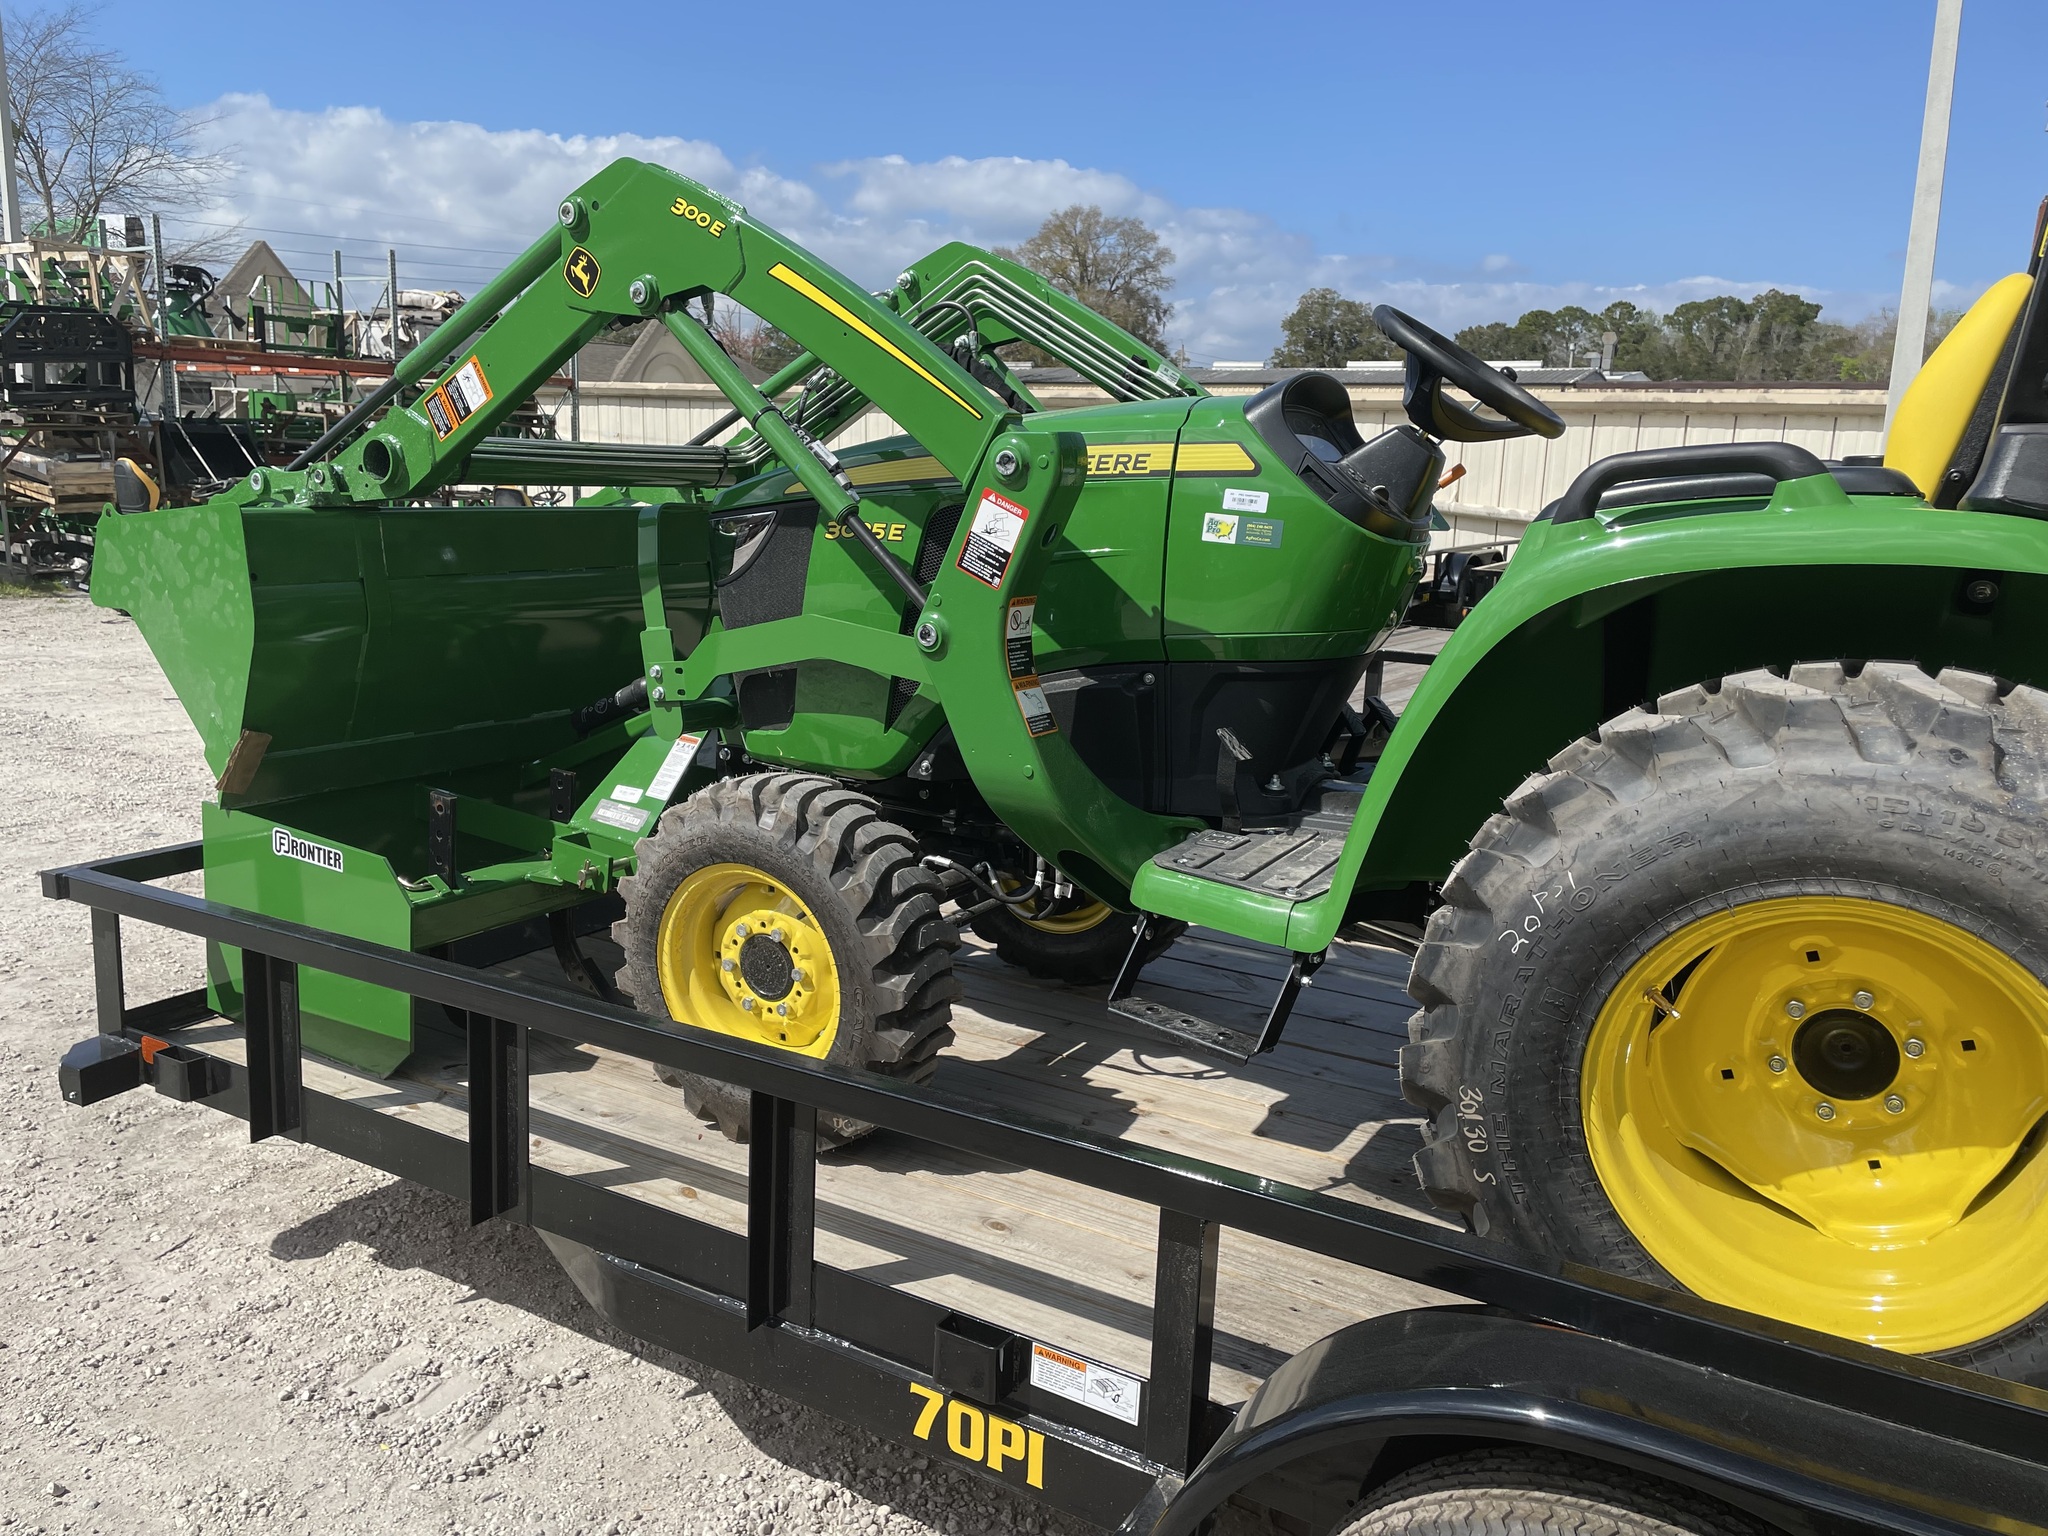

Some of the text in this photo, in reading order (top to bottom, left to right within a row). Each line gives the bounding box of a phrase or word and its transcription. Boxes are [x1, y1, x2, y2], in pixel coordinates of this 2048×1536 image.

[670, 197, 727, 239] 300E
[996, 497, 1023, 516] DANGER
[824, 520, 906, 541] 305E
[274, 829, 342, 870] FRONTIER
[1489, 831, 1696, 1096] MARATHONER
[1491, 1113, 1526, 1205] THE
[1044, 1350, 1081, 1371] WARNING
